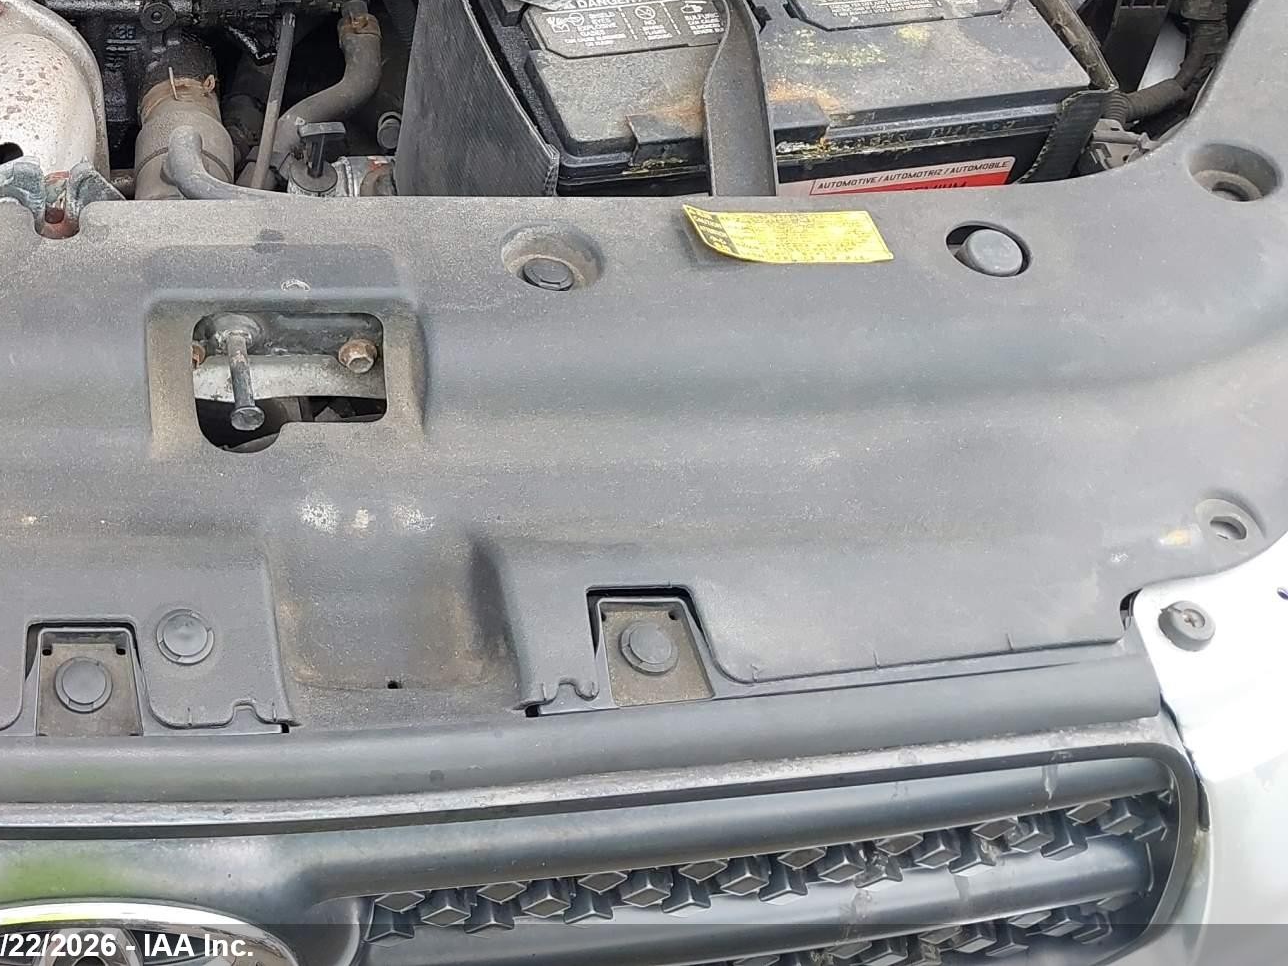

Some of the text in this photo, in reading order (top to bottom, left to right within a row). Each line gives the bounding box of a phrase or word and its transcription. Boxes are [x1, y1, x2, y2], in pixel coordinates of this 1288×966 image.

[817, 176, 878, 190] AUTOMOTIVE
[883, 168, 944, 182] AUTOMOTRIZ
[950, 160, 1010, 174] AUTOMOBILE
